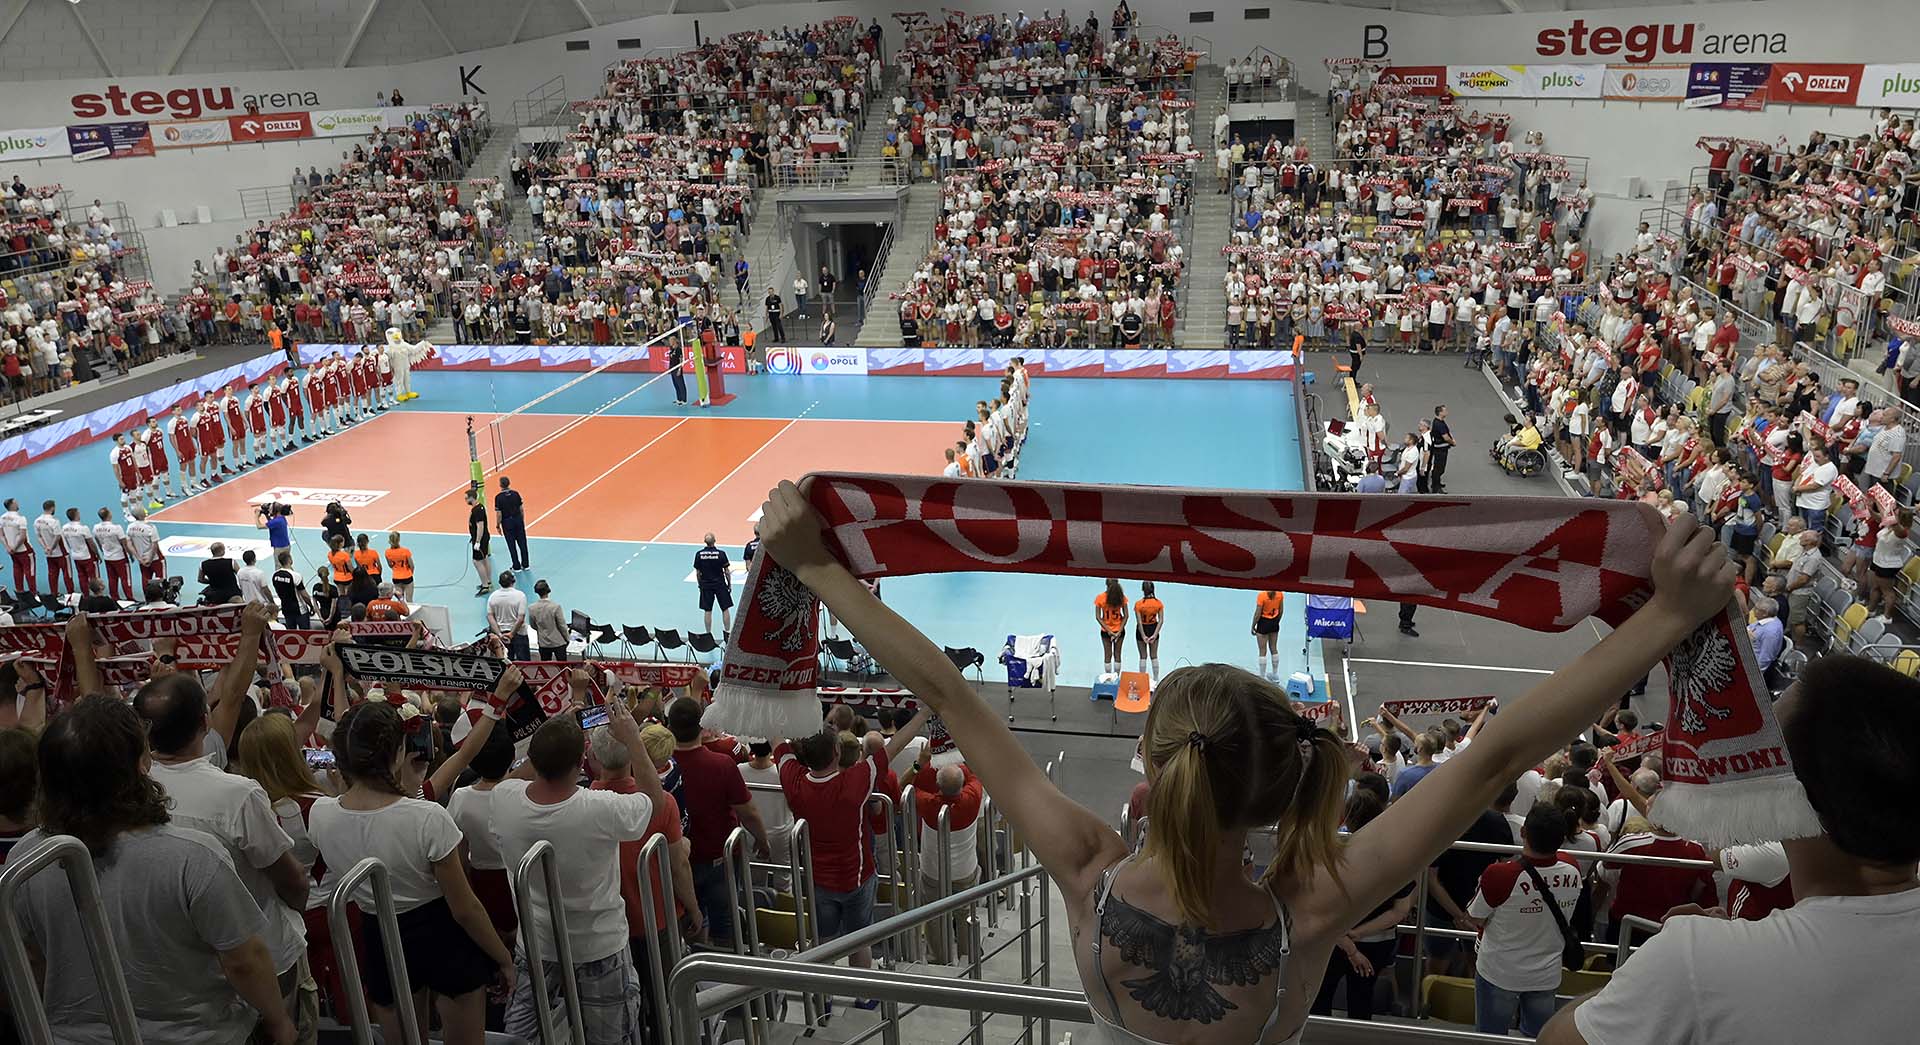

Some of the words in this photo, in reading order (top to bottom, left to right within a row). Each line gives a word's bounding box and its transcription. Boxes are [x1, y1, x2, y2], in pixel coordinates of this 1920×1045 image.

[1363, 24, 1389, 59] B
[1535, 19, 1695, 63] stegu
[1703, 32, 1787, 55] arena
[459, 65, 487, 96] K
[1406, 77, 1435, 86] ORLEN
[1459, 71, 1493, 79] BLACHY
[1542, 72, 1574, 90] plus
[1809, 78, 1847, 90] ORLEN
[71, 85, 235, 119] stegu
[242, 90, 321, 112] arena
[266, 120, 300, 131] ORLEN
[336, 114, 383, 125] LeaseTake
[0, 136, 34, 154] plus
[830, 358, 858, 366] OPOLE
[826, 481, 1608, 626] POLSKA
[1104, 610, 1120, 621] 15
[343, 648, 495, 680] POLSKA
[439, 680, 489, 691] FANATYCY
[514, 717, 543, 739] POLSKA
